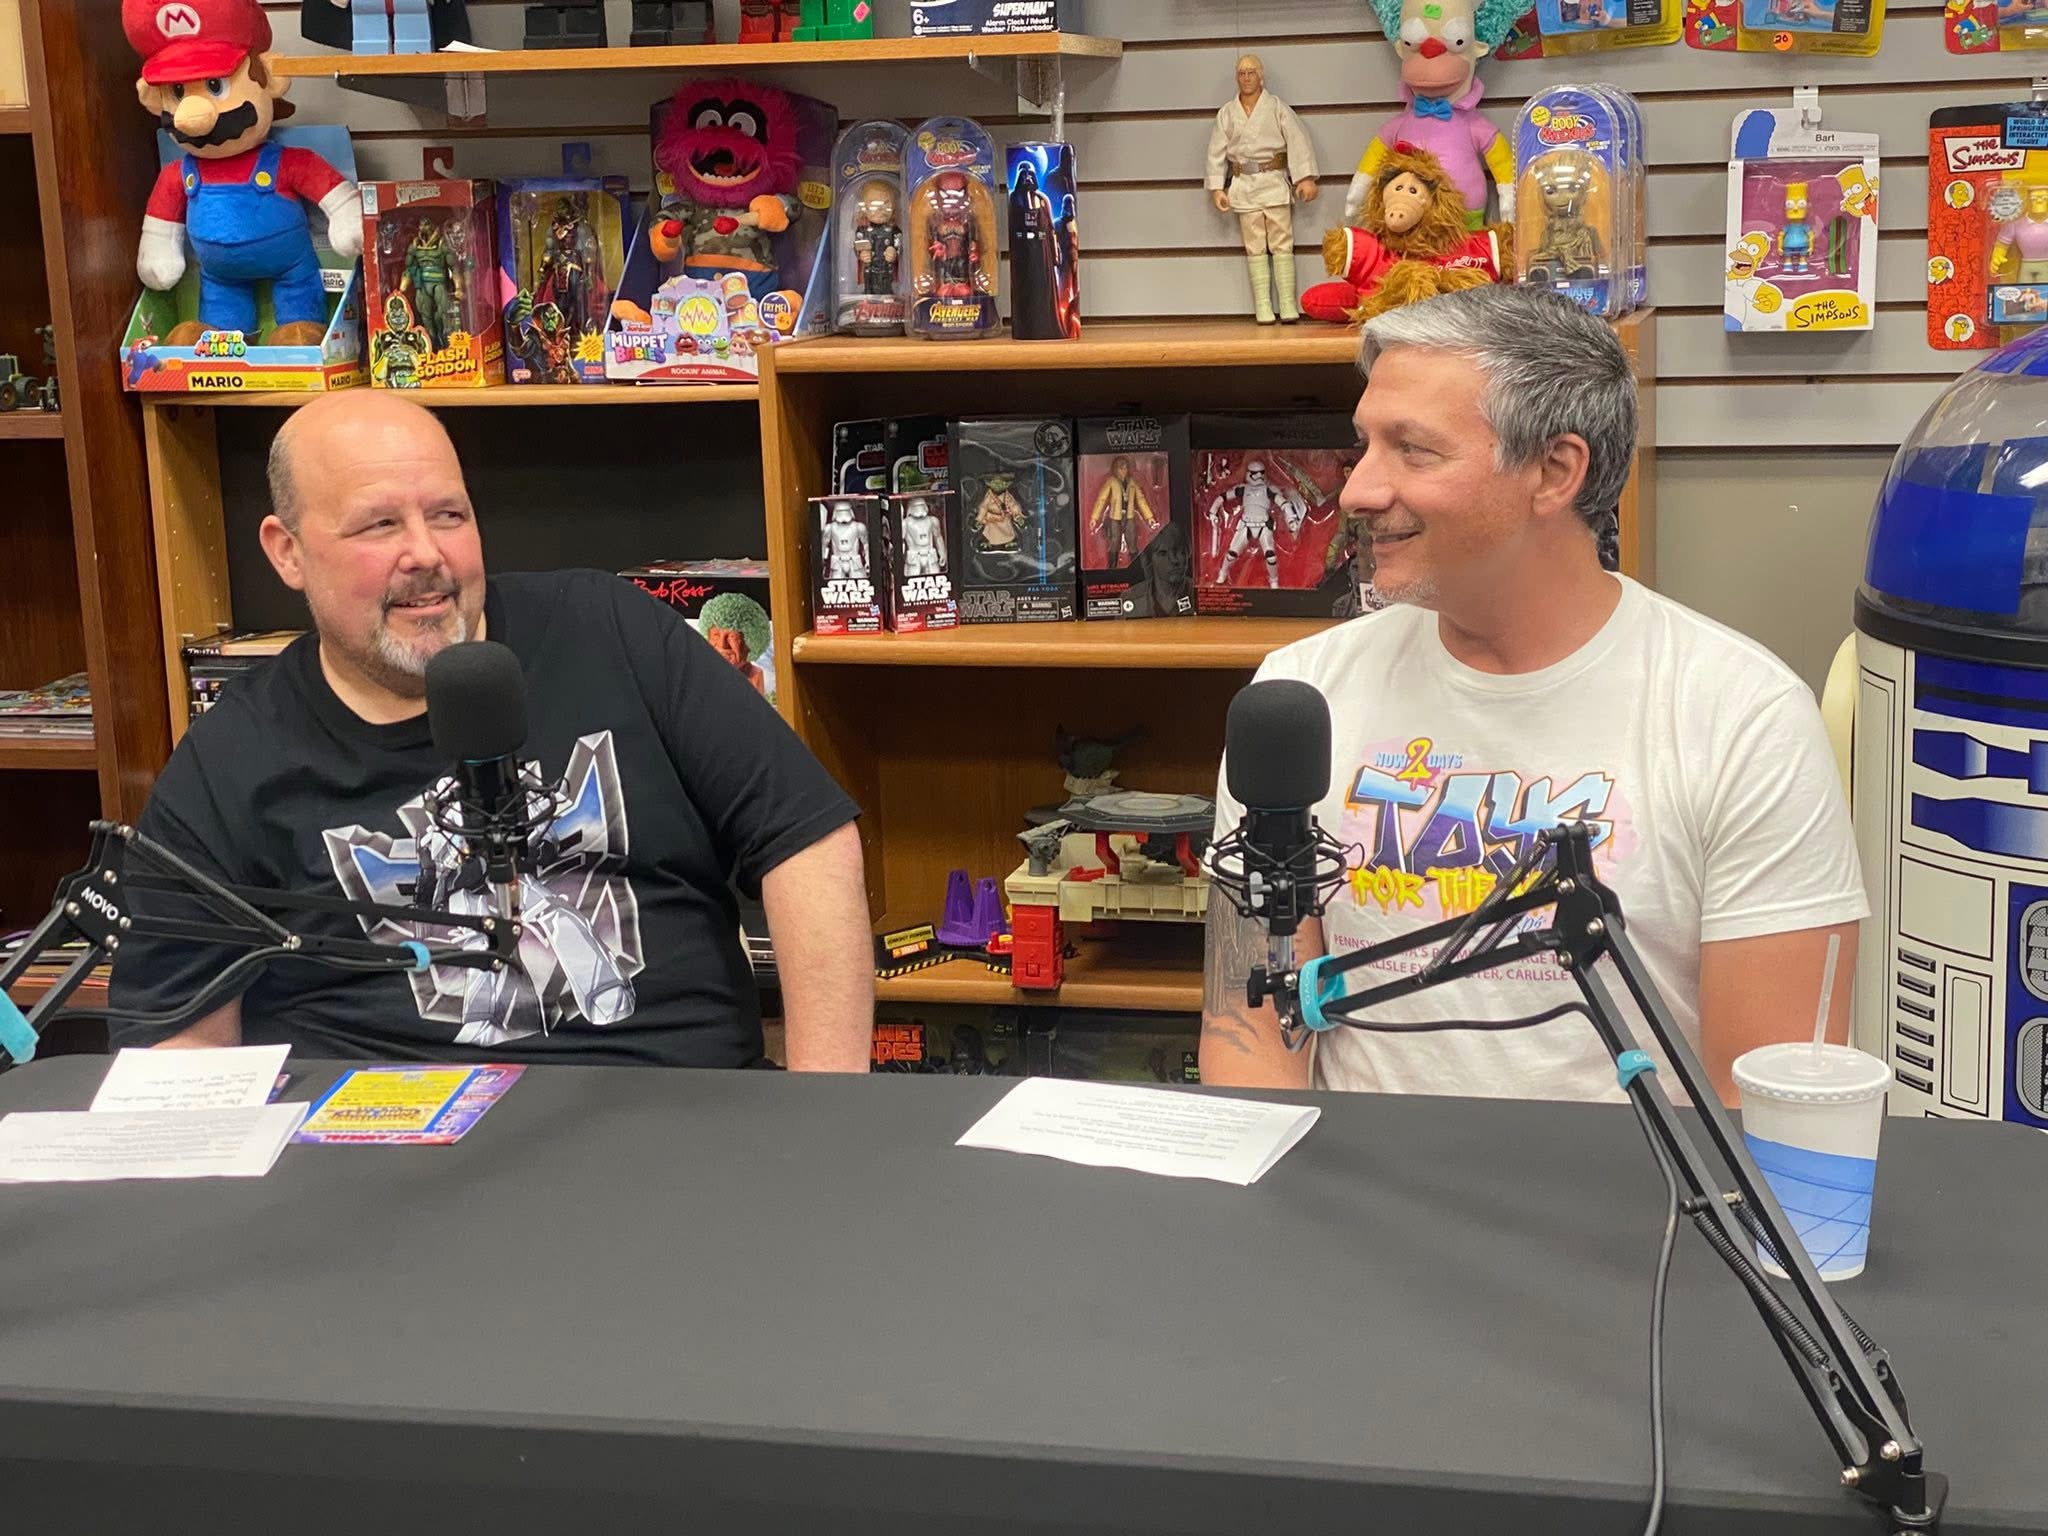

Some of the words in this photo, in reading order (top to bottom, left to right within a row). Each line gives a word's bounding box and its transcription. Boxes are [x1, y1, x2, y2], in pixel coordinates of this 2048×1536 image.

[912, 8, 930, 25] 6+
[992, 1, 1048, 17] SUPERMAN
[981, 25, 1006, 33] Wecker
[1011, 23, 1054, 33] Despertador
[985, 17, 1006, 26] Alarm
[1006, 17, 1024, 26] Clock
[1775, 34, 1789, 44] 20
[1815, 133, 1835, 142] Bart
[1973, 138, 1998, 151] THE
[1951, 145, 2020, 170] SIMPSONS
[763, 302, 775, 312] TRY
[1813, 299, 1837, 310] THE
[1793, 305, 1860, 328] SIMPSONS
[201, 331, 242, 343] SUPER
[610, 332, 669, 349] MUPPET
[194, 341, 247, 357] MARIO
[417, 347, 469, 366] FLASH
[614, 346, 667, 364] BABIES
[415, 358, 477, 379] GORDON
[671, 367, 700, 376] ROCKIN'
[701, 368, 728, 376] ANIMAL
[191, 376, 244, 388] MARIO
[331, 375, 350, 388] MARIO
[1105, 417, 1161, 432] STAR
[1106, 430, 1162, 446] WARS
[821, 579, 874, 592] STAR
[902, 575, 951, 590] STAR
[670, 578, 714, 607] Ross
[821, 590, 874, 605] WARS
[902, 587, 951, 602] WARS
[960, 590, 1015, 604] STAR
[960, 600, 1015, 618] WARS
[1375, 752, 1408, 769] NOW
[1395, 737, 1433, 782] 2
[1427, 752, 1464, 769] DAYS
[1351, 864, 1426, 909] FOR
[1426, 866, 1498, 912] THE
[80, 885, 119, 921] MOVO
[1506, 969, 1569, 981] CARLISLE
